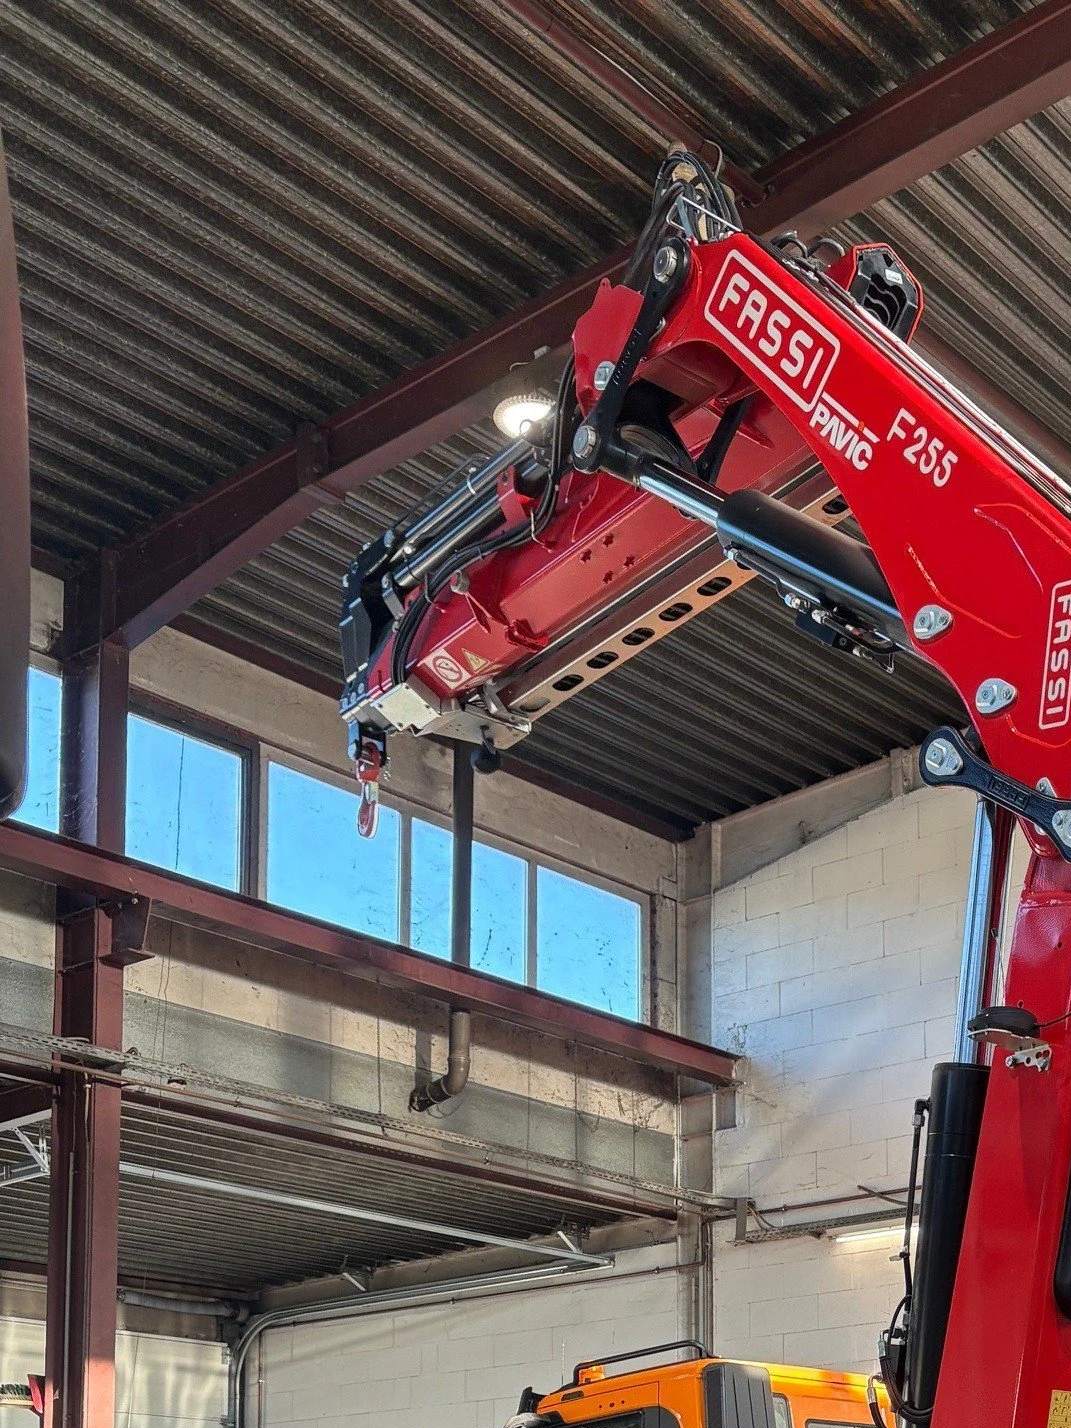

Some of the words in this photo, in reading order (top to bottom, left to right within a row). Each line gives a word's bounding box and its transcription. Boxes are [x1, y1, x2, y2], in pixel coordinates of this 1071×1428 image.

[718, 272, 824, 390] FASSI
[809, 401, 873, 471] PAVIC
[886, 407, 959, 488] F255
